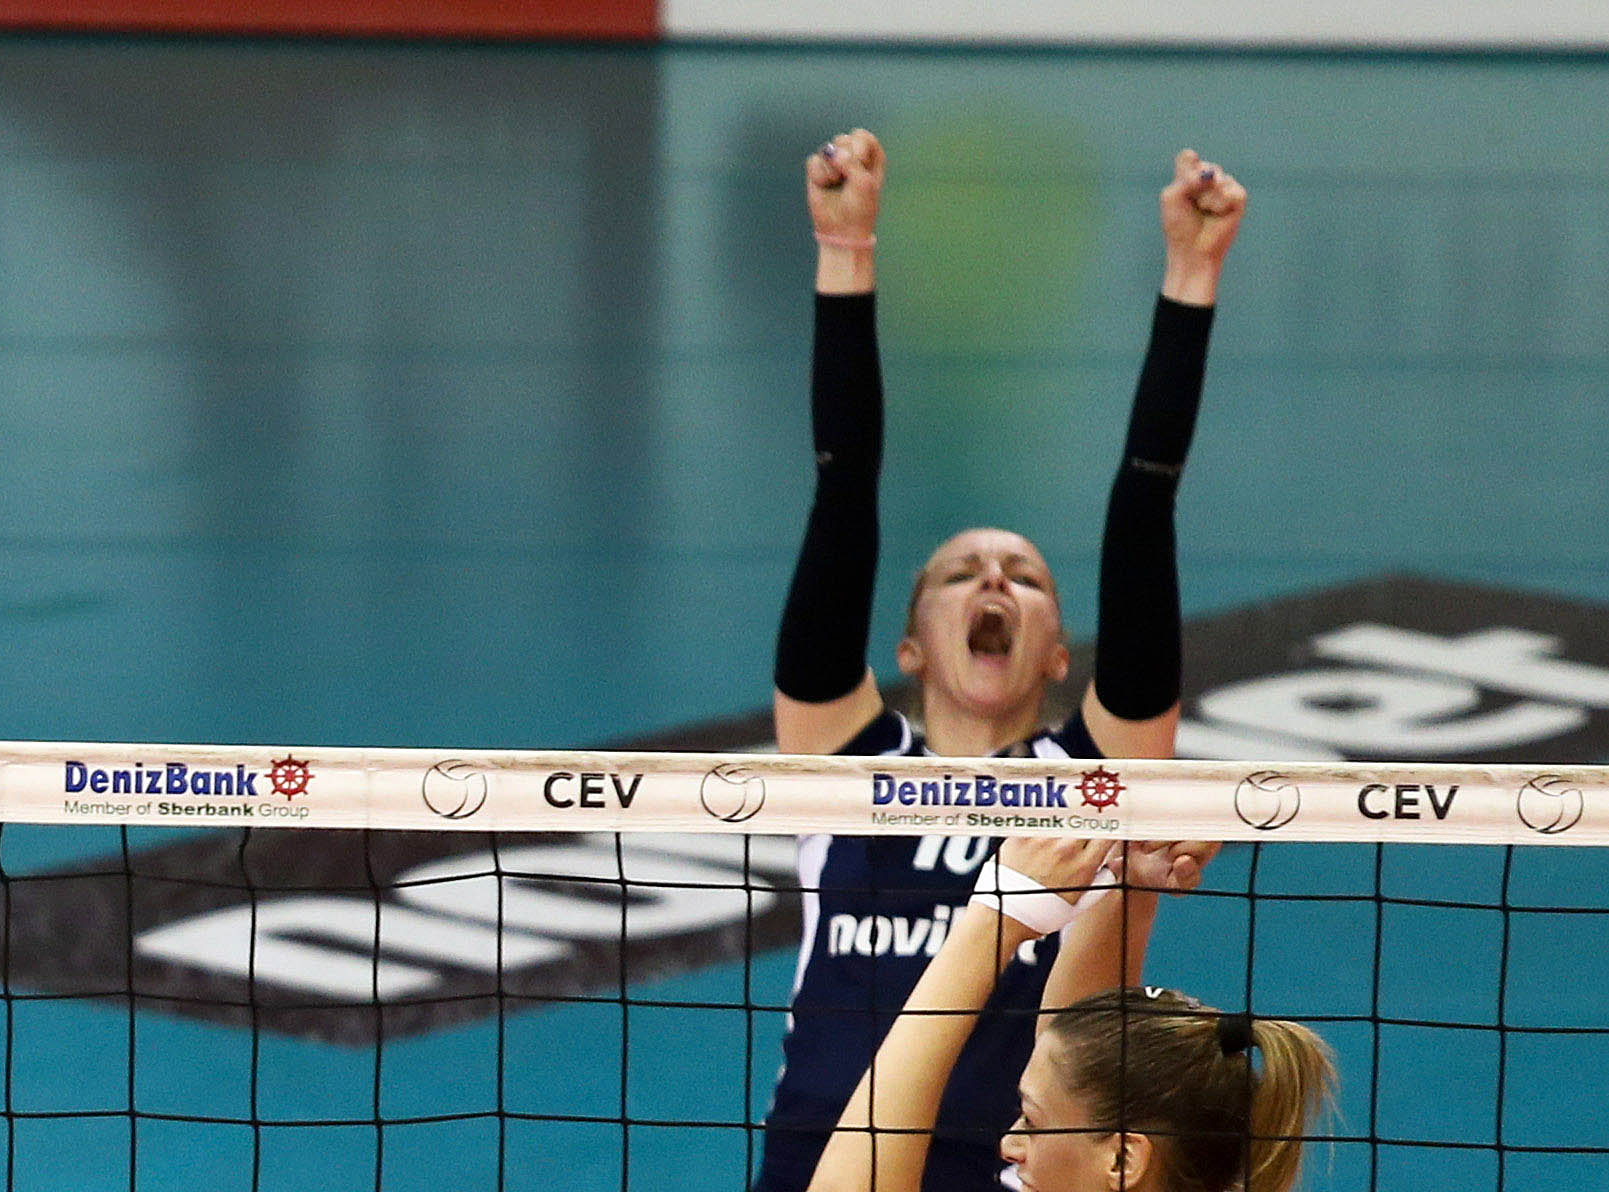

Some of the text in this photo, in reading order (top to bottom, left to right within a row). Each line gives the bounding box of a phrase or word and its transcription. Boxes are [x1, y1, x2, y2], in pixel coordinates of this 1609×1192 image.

[64, 760, 258, 796] DenizBank
[543, 771, 644, 809] CEV
[872, 773, 1068, 808] DenizBank
[64, 801, 310, 819] Member of Sberbank Group
[1357, 783, 1459, 820] CEV
[872, 812, 1120, 831] Member of Sberbank Group
